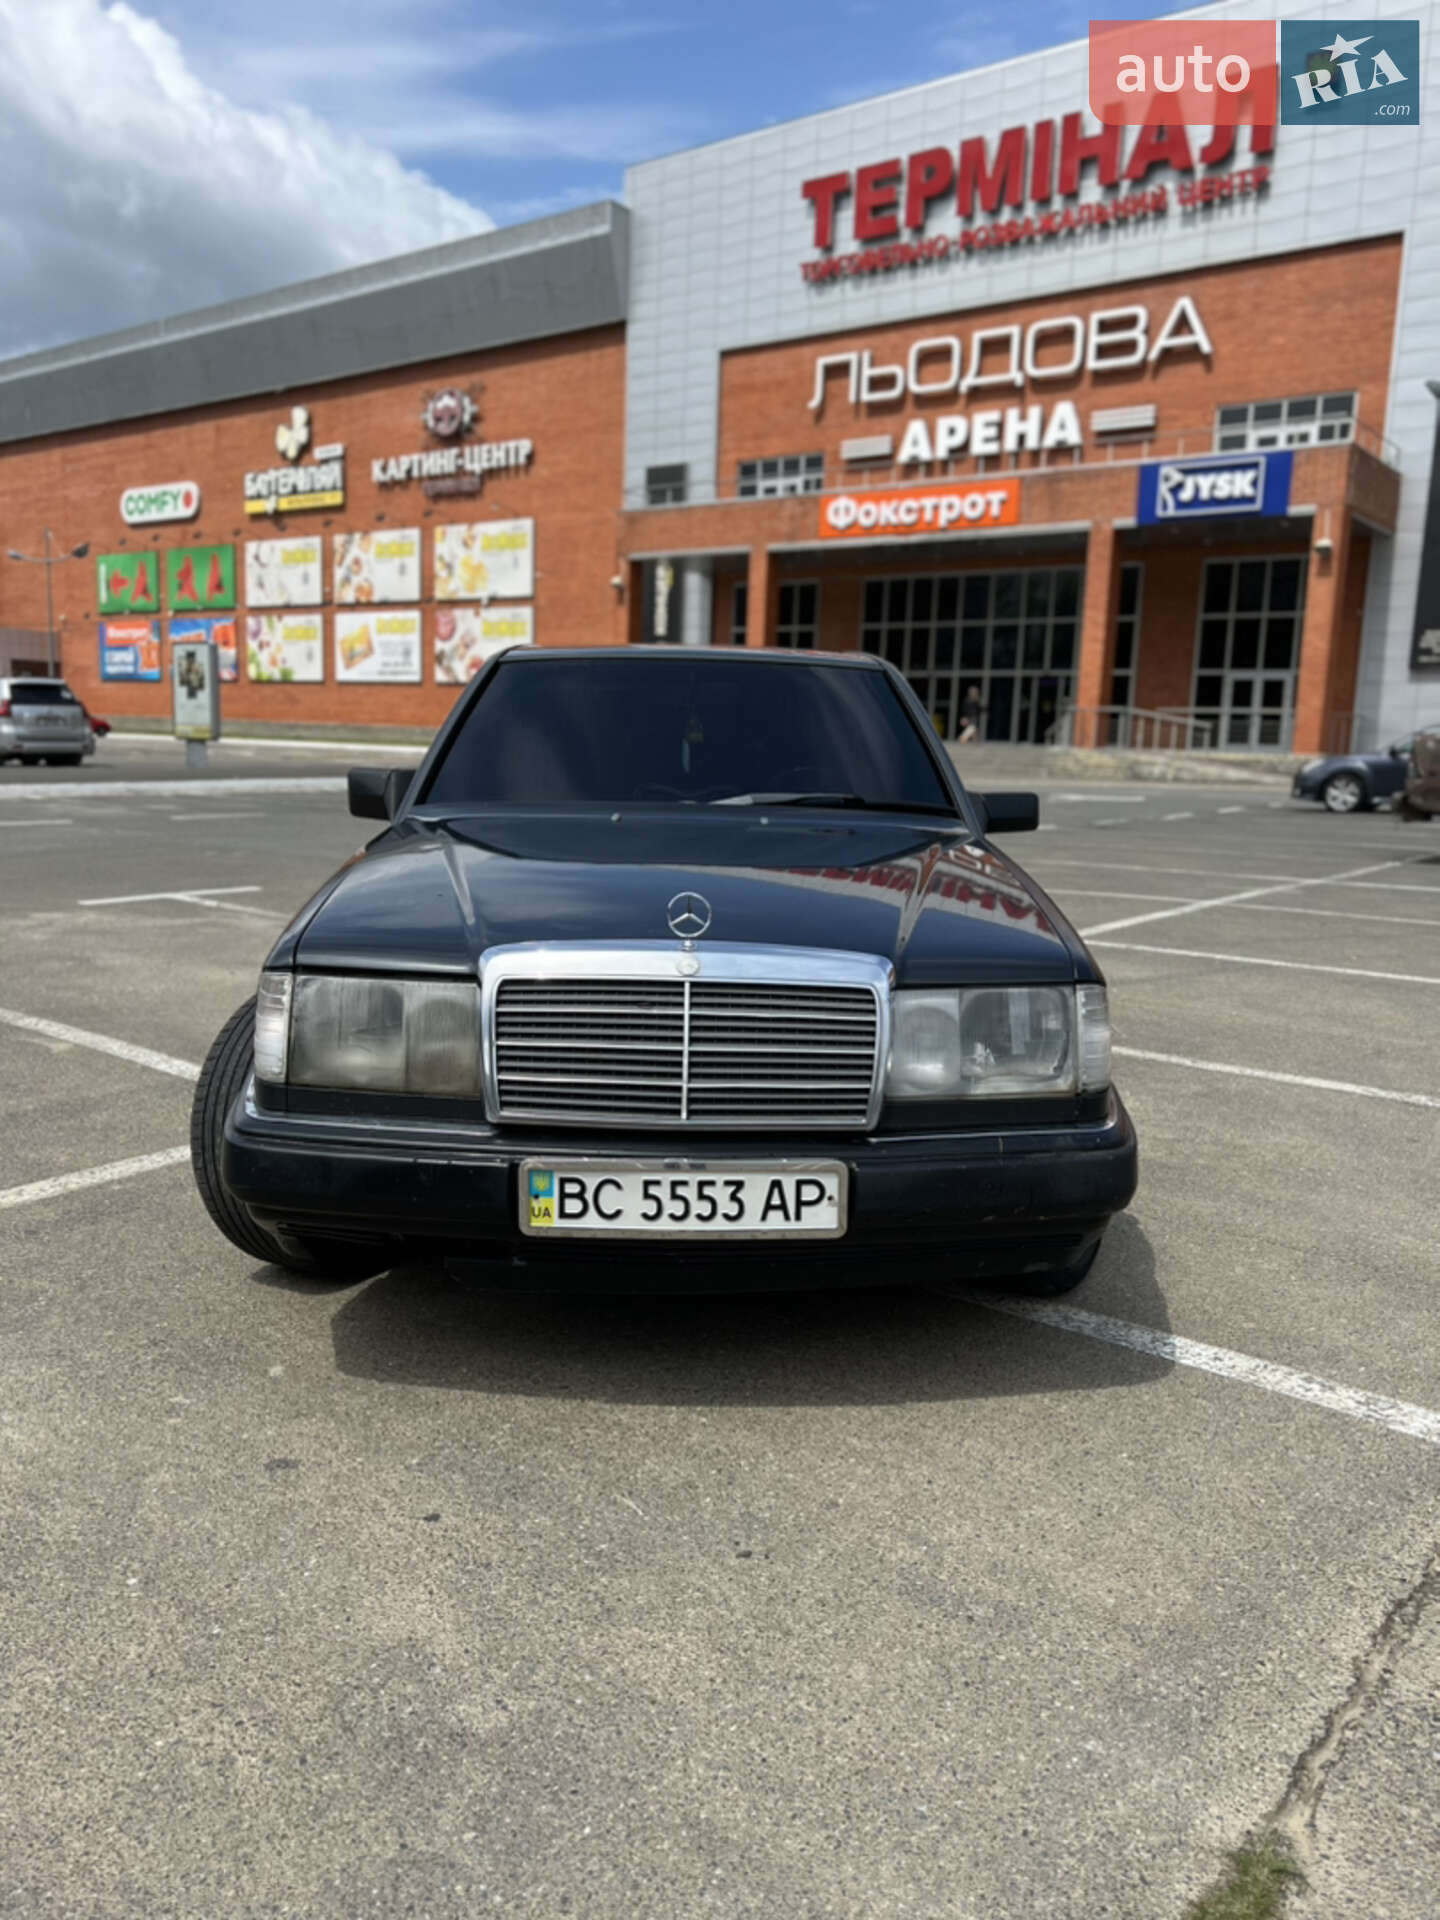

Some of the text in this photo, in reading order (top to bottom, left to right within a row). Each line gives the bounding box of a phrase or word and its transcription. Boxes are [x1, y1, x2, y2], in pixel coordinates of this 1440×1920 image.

[802, 66, 1278, 249] ТЕРМІНАЛ
[808, 296, 1212, 410] ЛЬОДОВА
[897, 401, 1083, 464] АРЕНА
[372, 438, 532, 482] КАРТИНГ-ЦЕНТР
[124, 488, 181, 516] COMFY
[1179, 468, 1257, 502] JYSK
[826, 489, 1006, 530] Фокстрот
[531, 1205, 552, 1219] UA
[558, 1177, 826, 1222] BC 5553 AP
